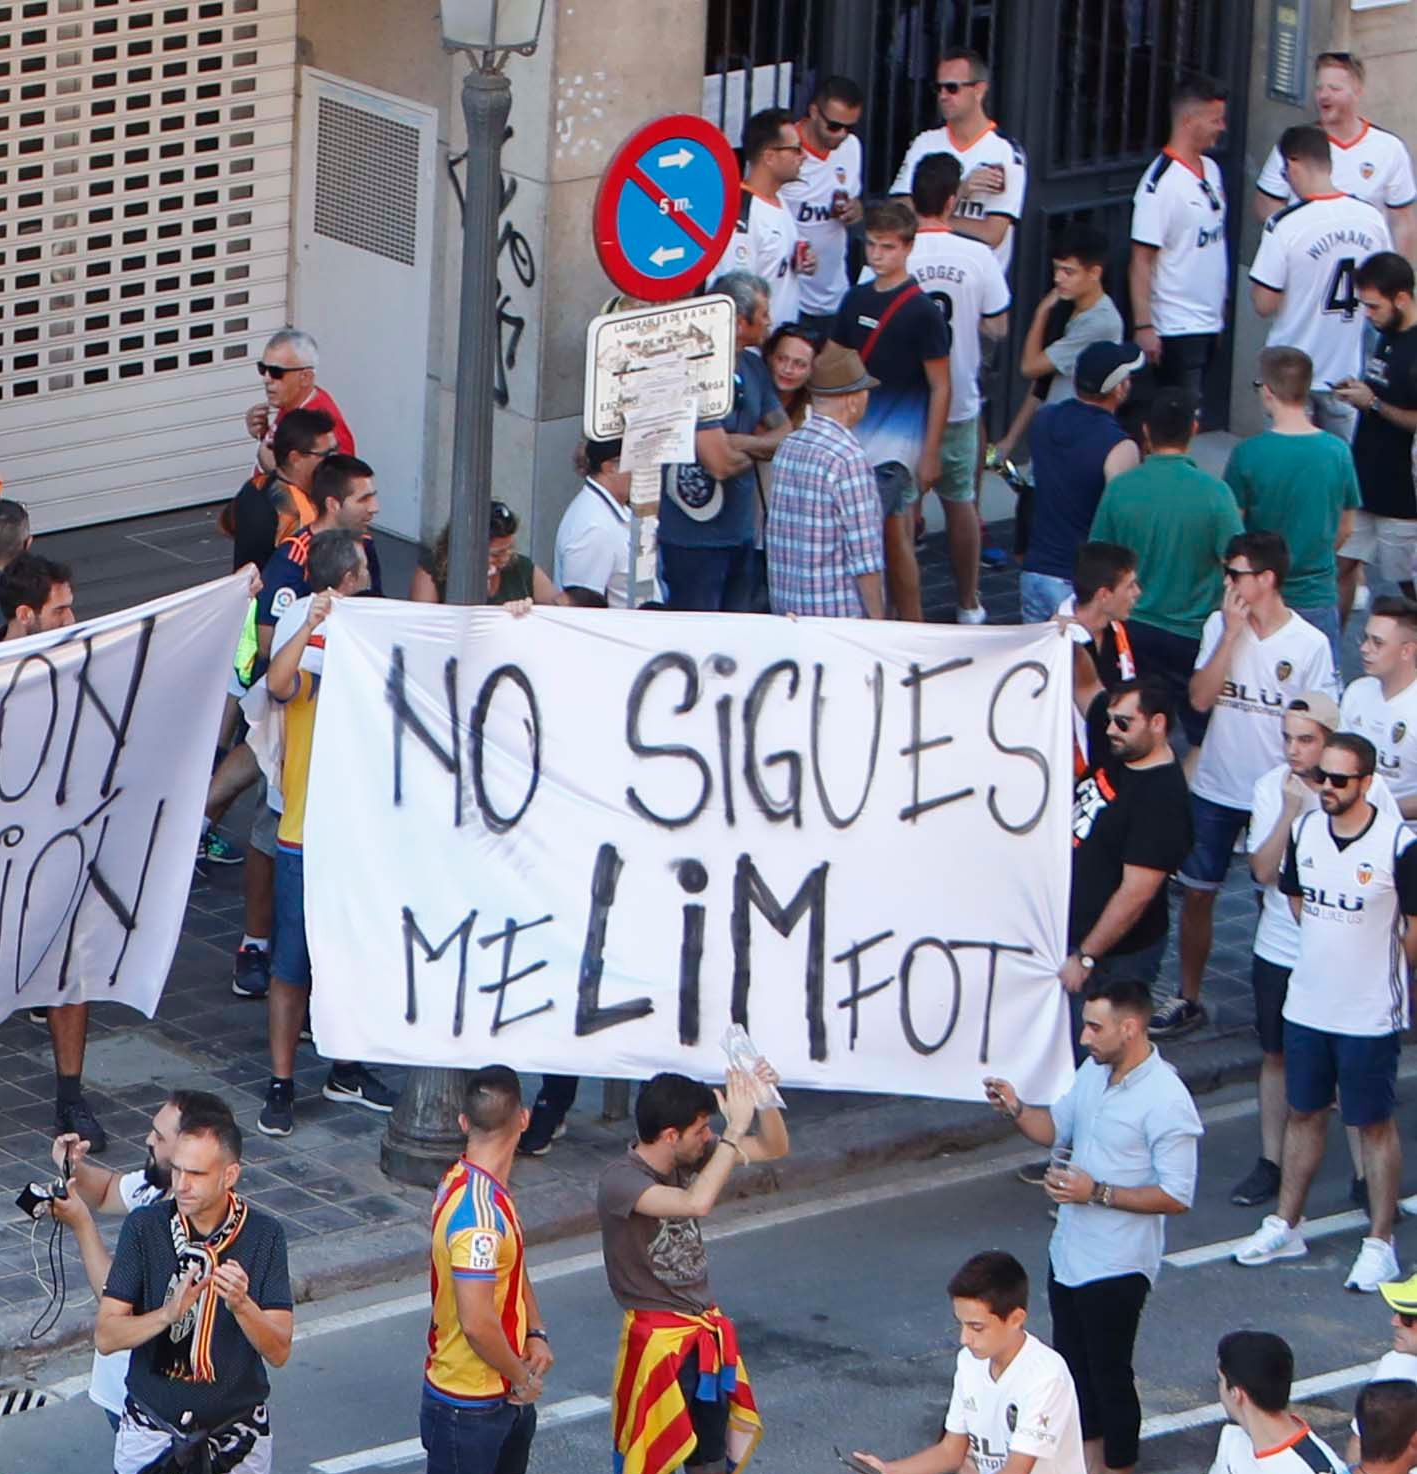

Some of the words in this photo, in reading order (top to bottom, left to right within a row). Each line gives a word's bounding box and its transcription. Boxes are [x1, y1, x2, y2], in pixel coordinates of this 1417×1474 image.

[659, 198, 671, 216] 5
[1323, 257, 1361, 322] 4
[386, 644, 543, 836] NO
